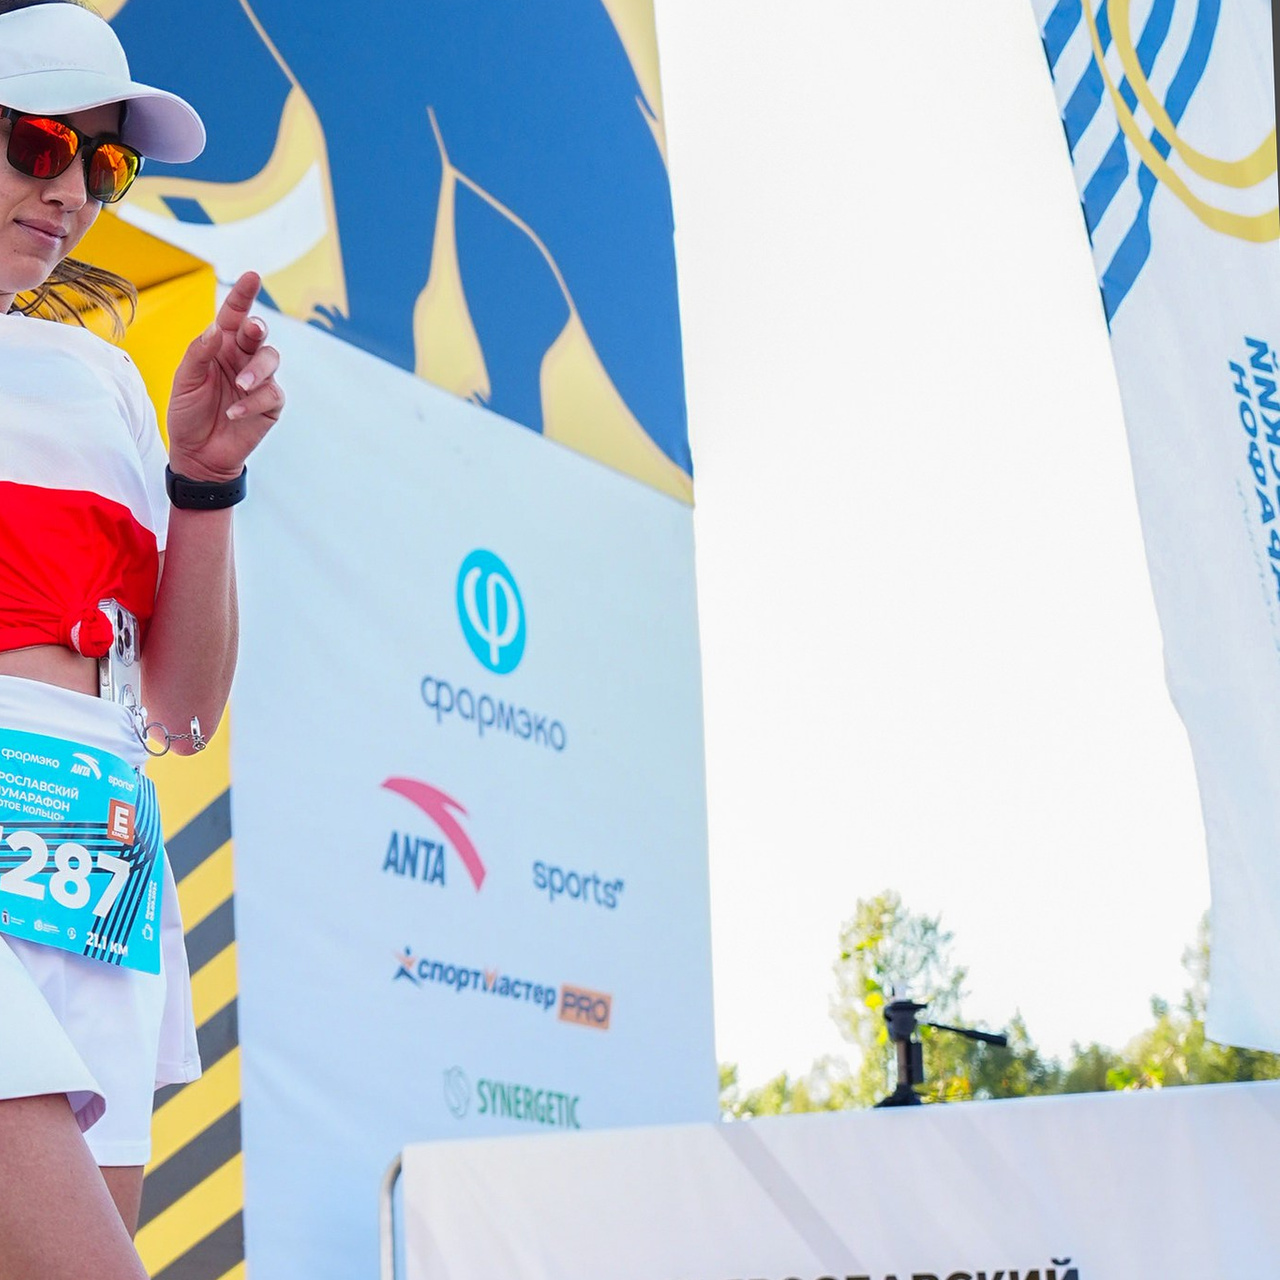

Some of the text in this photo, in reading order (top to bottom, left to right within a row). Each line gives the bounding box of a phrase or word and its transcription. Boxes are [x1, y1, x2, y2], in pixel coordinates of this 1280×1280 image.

[419, 676, 567, 752] фармэко
[1, 745, 61, 770] фармэко
[22, 804, 66, 823] КОЛЬЦО»
[382, 830, 446, 887] ANTA
[85, 930, 108, 951] 21.1
[562, 991, 610, 1024] PRO
[477, 1077, 581, 1129] SYNERGETIC
